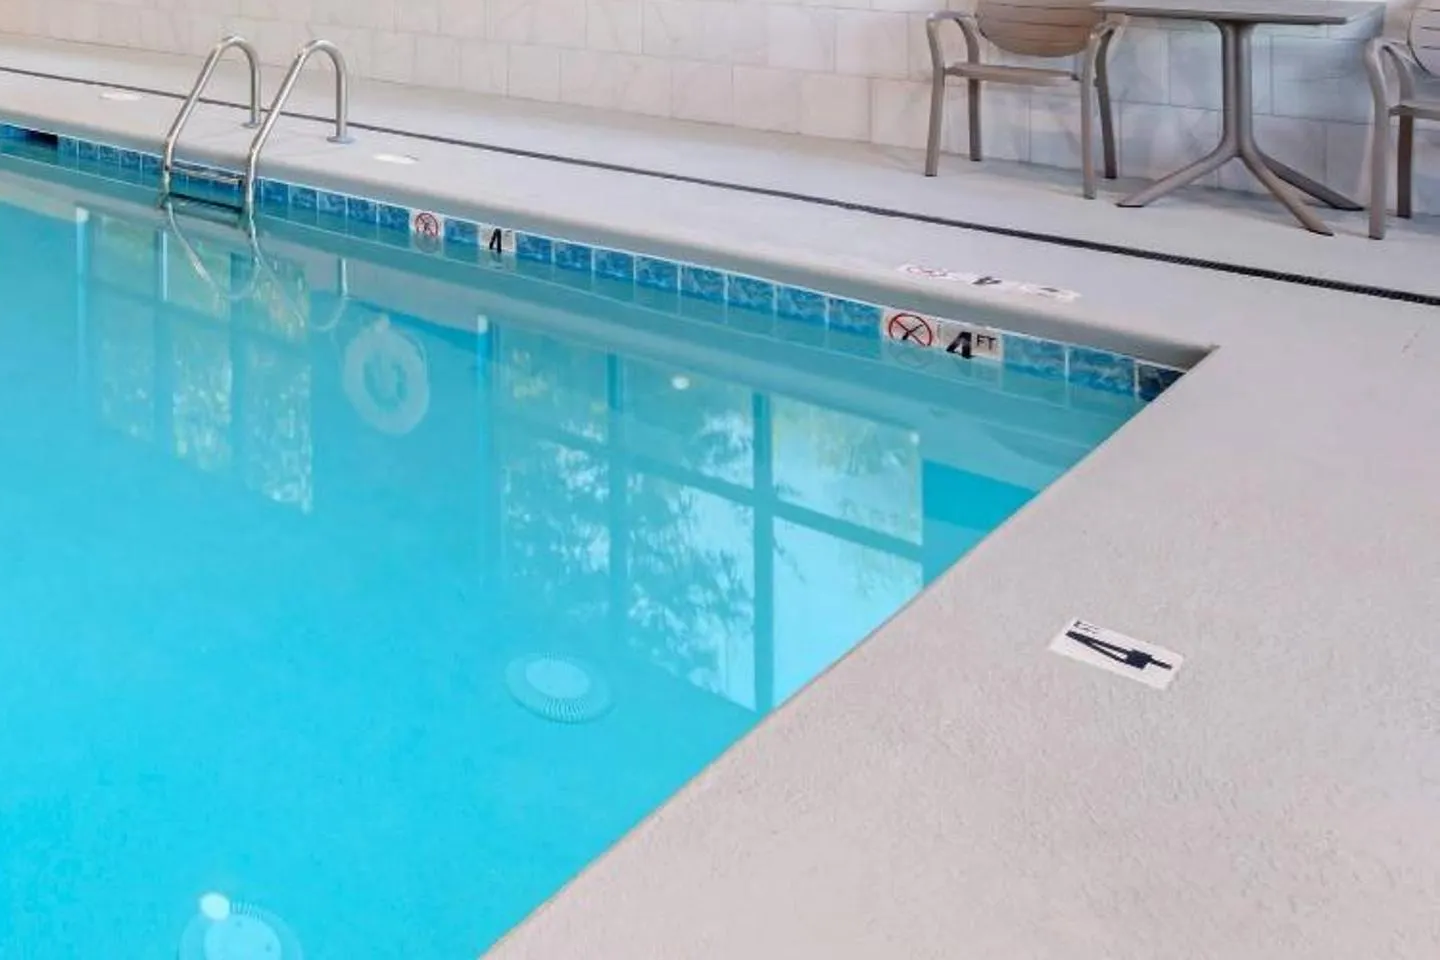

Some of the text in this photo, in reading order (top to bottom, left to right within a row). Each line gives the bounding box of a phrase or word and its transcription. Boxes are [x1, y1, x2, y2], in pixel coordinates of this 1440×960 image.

[946, 331, 997, 359] 4 FT
[1065, 630, 1173, 670] 4
